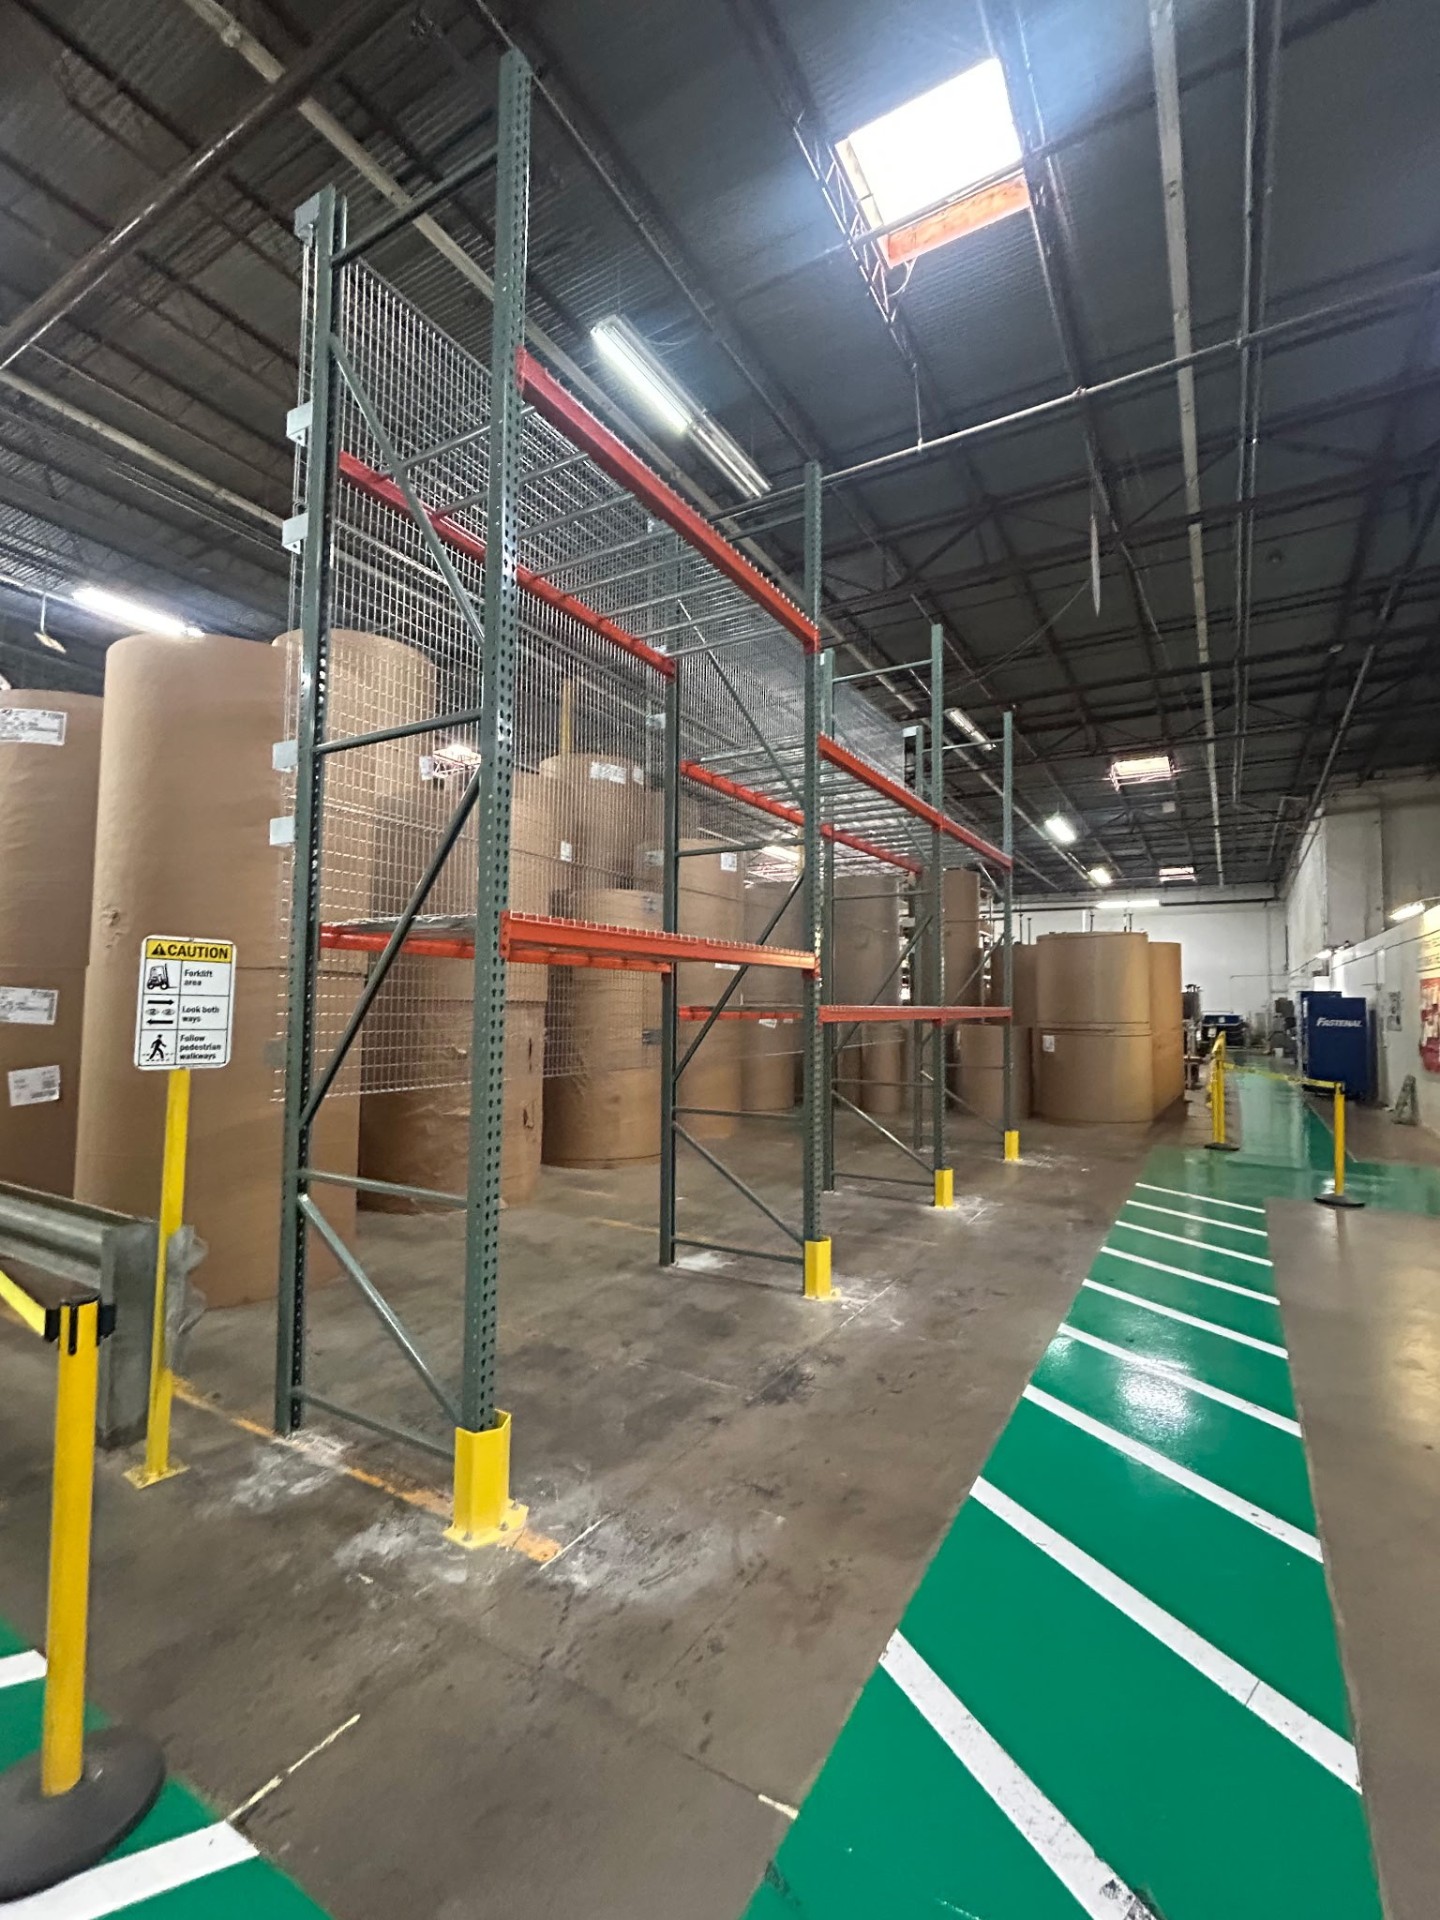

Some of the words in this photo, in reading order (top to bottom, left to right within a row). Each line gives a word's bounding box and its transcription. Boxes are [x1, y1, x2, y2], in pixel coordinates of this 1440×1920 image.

[167, 944, 228, 959] CAUTION
[184, 968, 213, 978] Forklift
[182, 1005, 201, 1014] Look
[202, 1006, 220, 1014] both
[182, 1015, 201, 1023] ways
[180, 1034, 205, 1042] Follow
[179, 1043, 221, 1052] pedestrian
[179, 1053, 216, 1061] walkways
